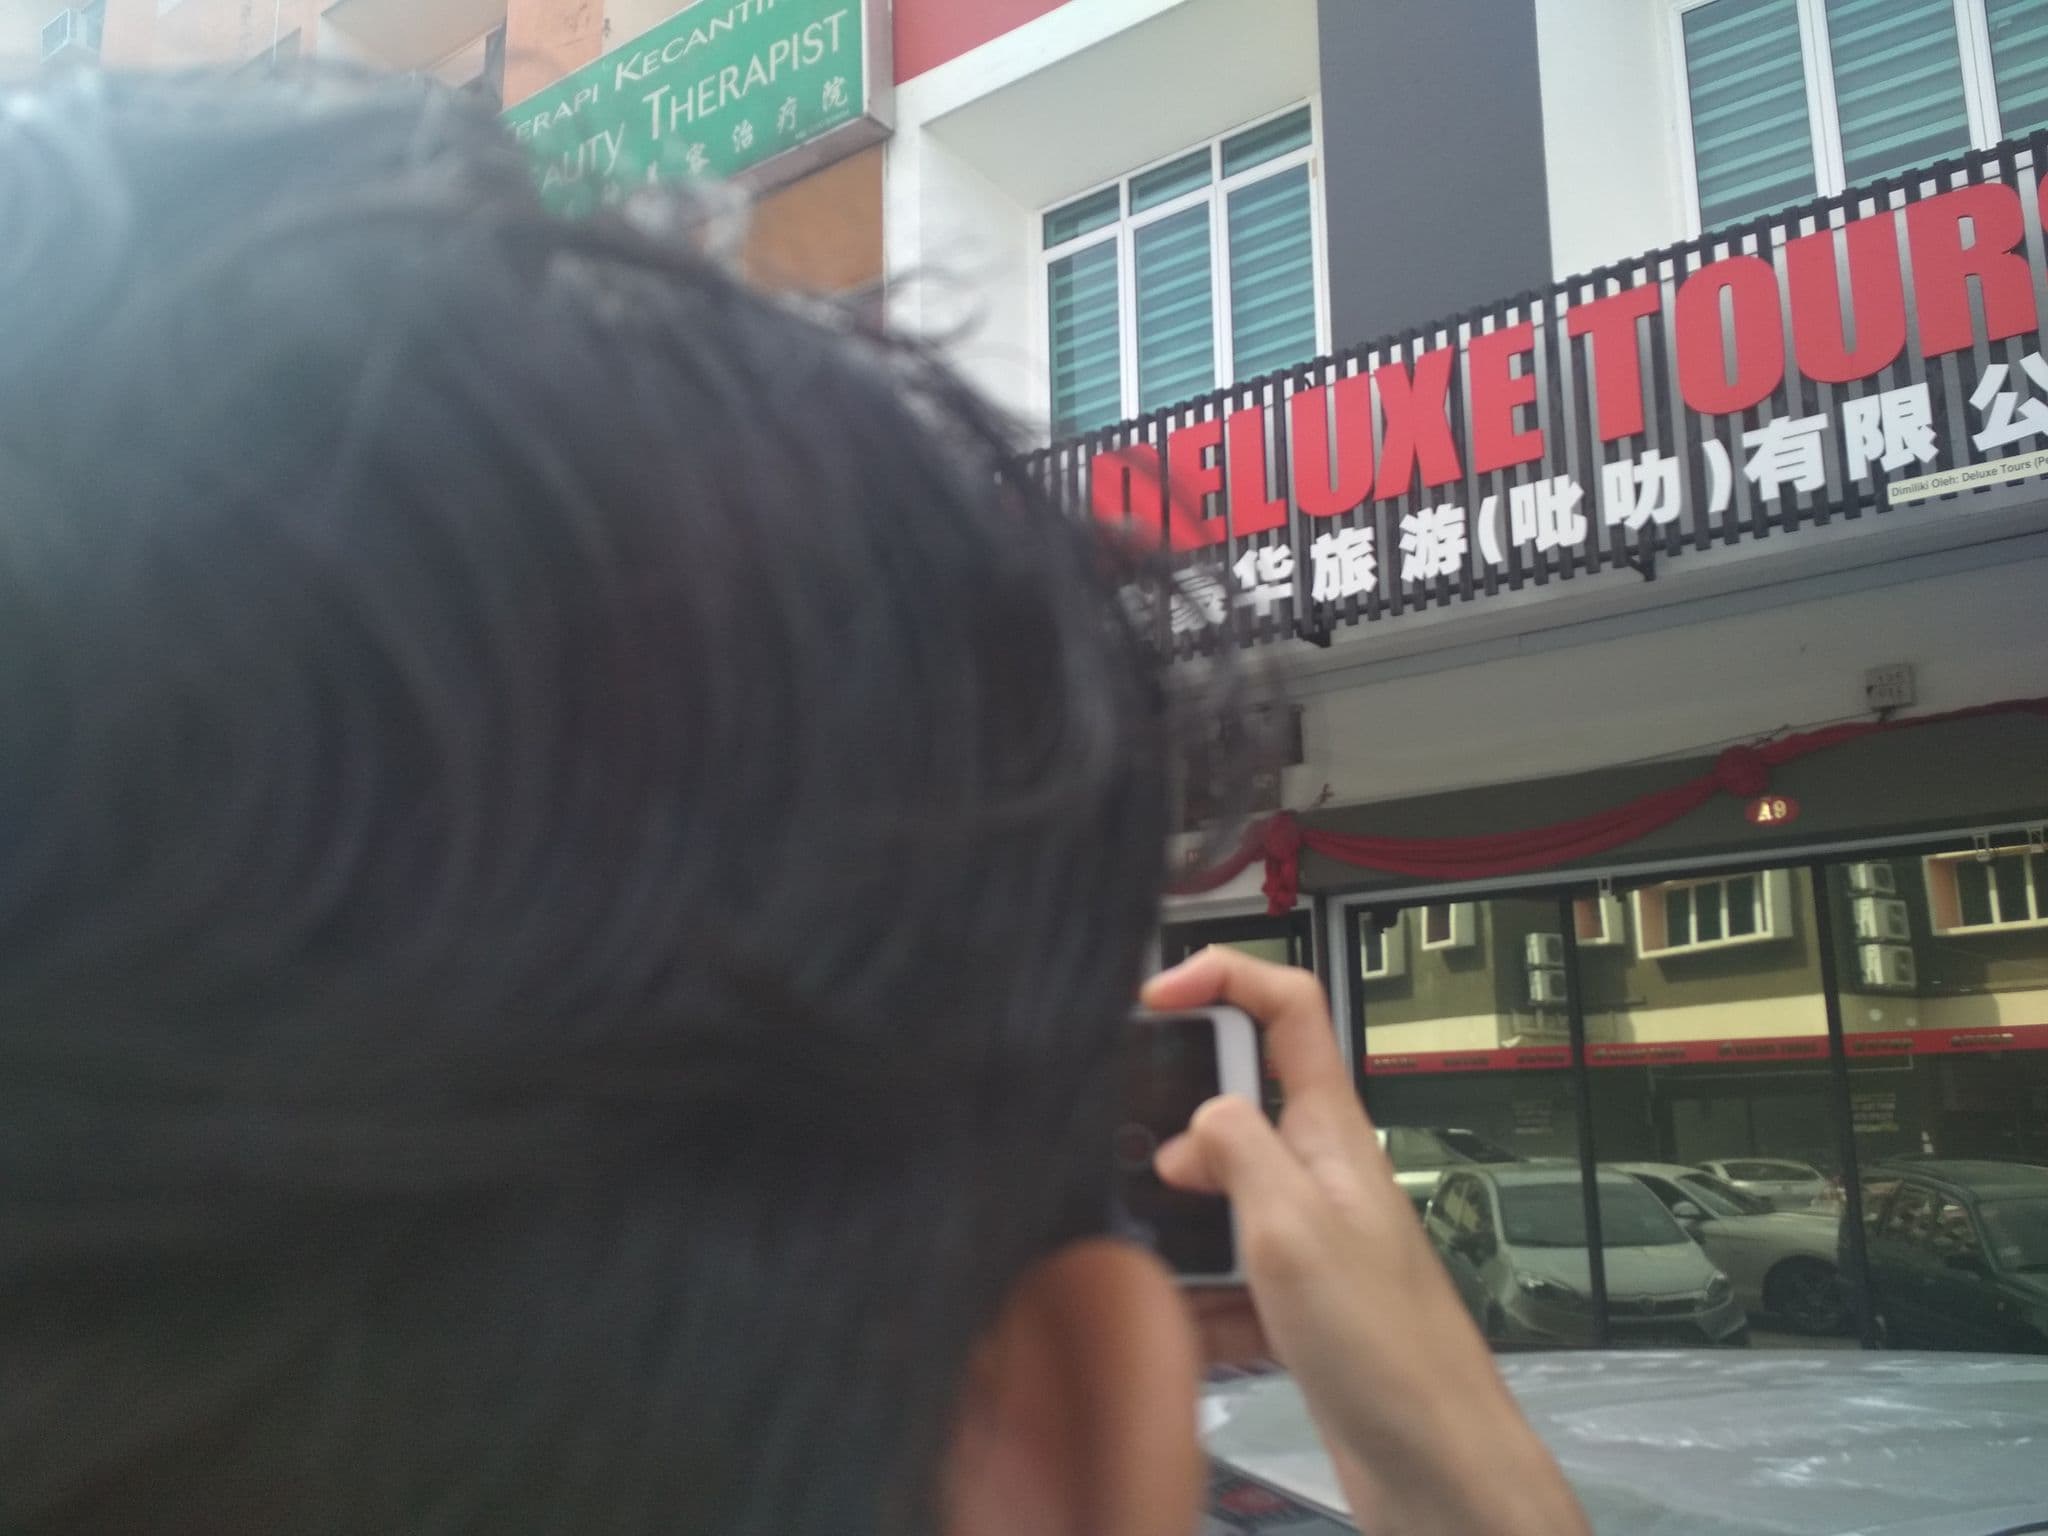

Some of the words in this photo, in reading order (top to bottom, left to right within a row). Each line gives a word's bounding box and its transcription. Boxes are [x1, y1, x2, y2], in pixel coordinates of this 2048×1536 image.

[641, 8, 849, 140] THERAPIST
[1091, 320, 1545, 554] DELUXE
[1566, 165, 2048, 443] TOUR
[1961, 465, 1998, 482] Deluxe
[1999, 459, 2032, 474] Tours
[1757, 799, 1787, 822] A9
